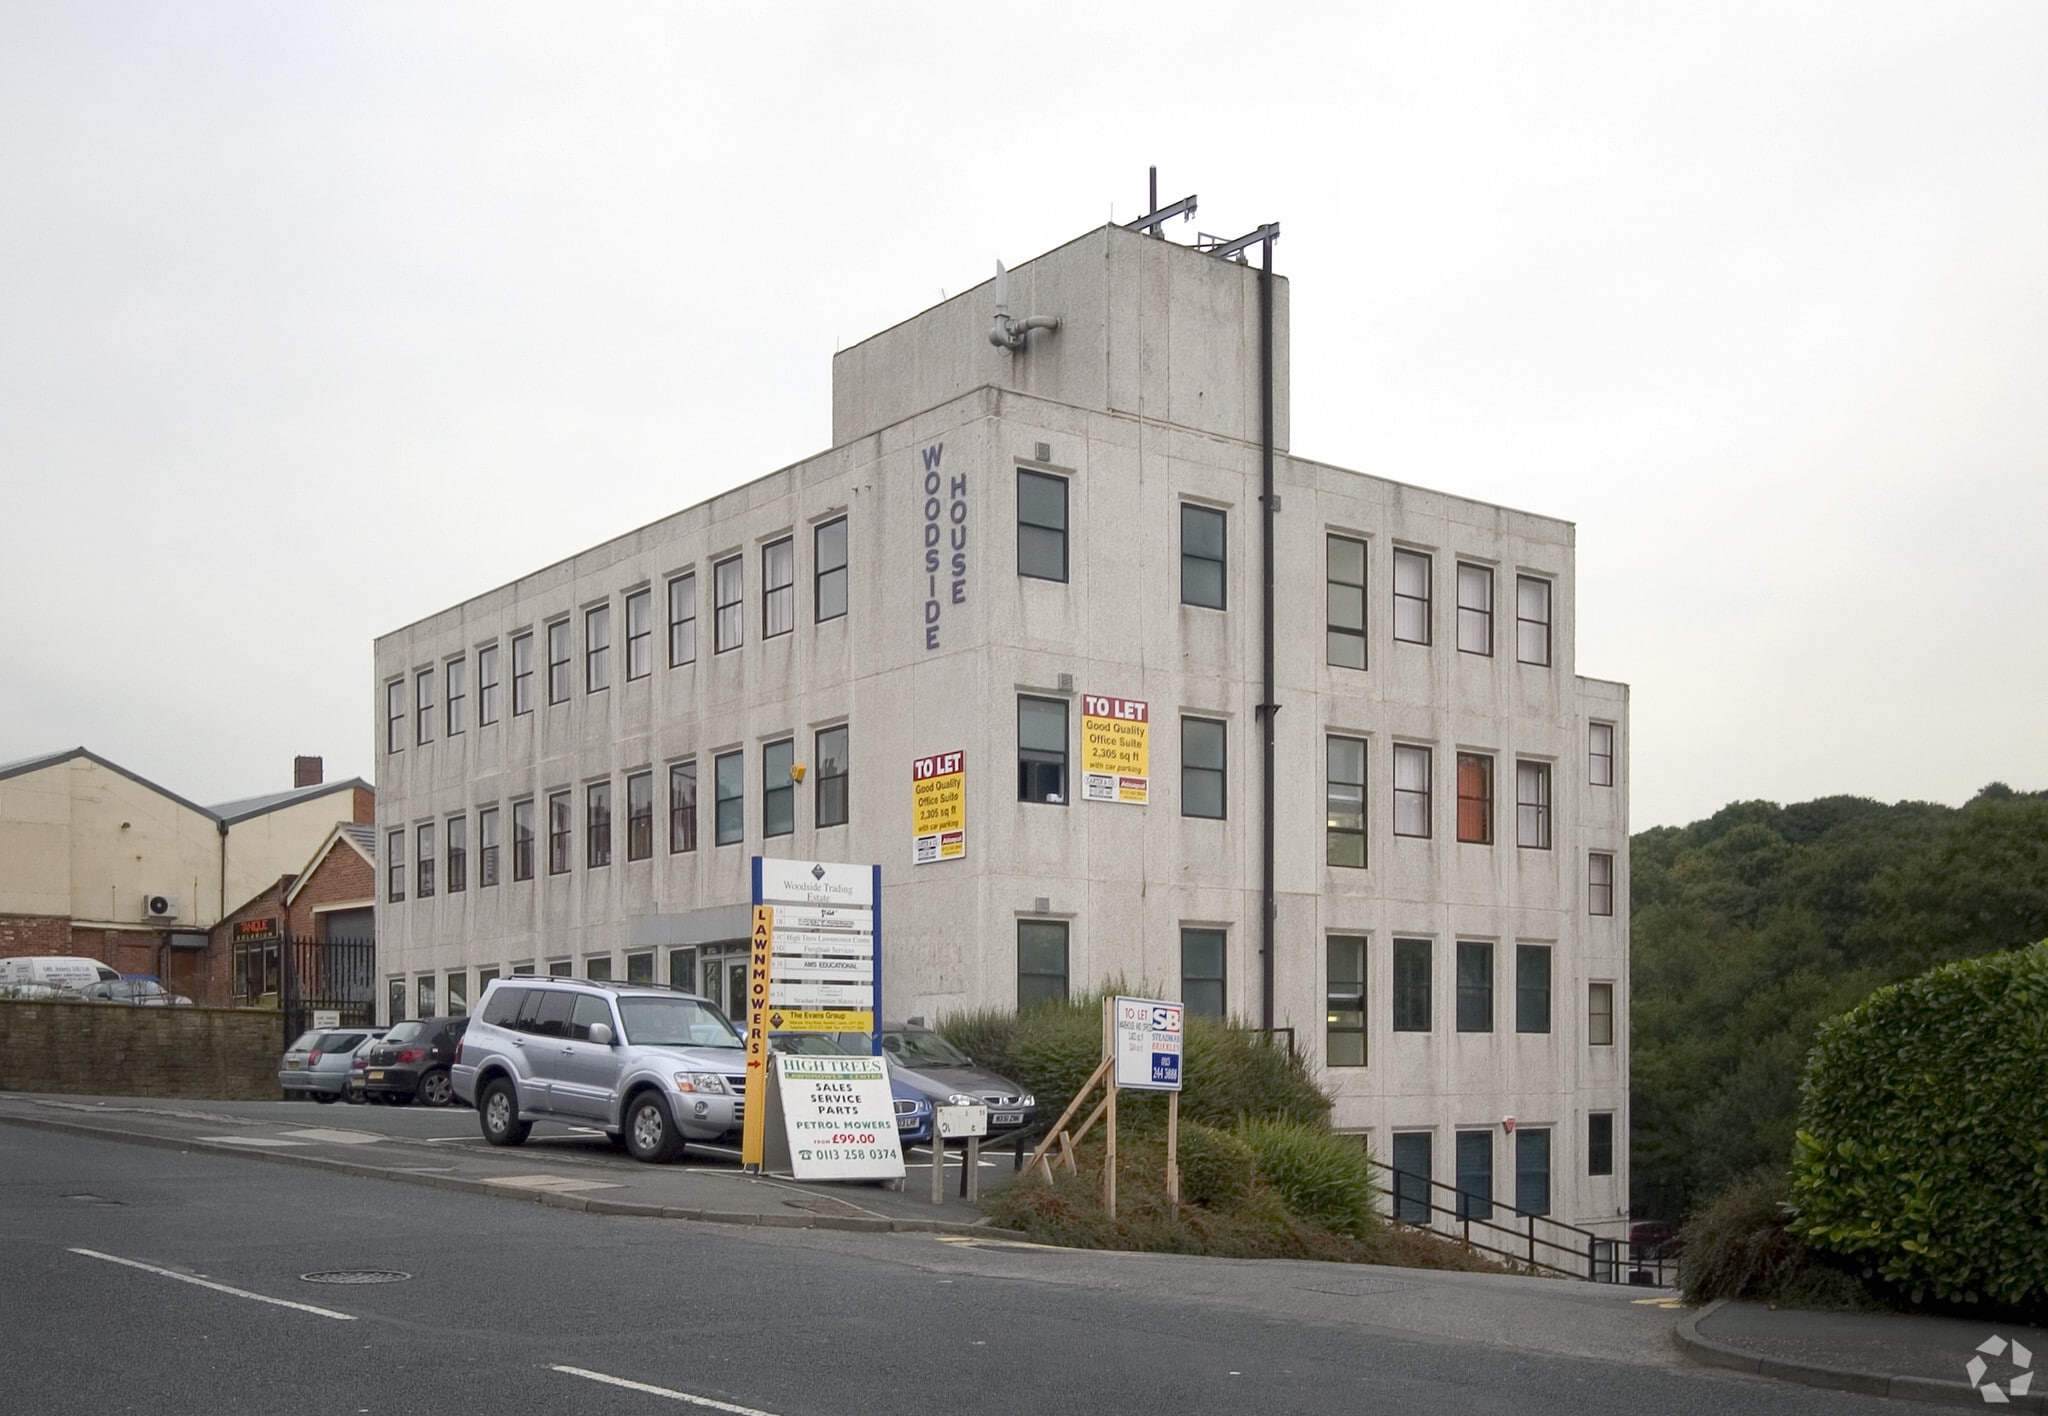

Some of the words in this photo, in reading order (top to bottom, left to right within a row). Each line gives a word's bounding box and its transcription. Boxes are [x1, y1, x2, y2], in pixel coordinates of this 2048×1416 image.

[950, 472, 967, 604] HOUSE
[922, 442, 943, 650] WOODSIDE
[1086, 696, 1109, 716] TO
[1114, 700, 1145, 720] LET
[1086, 720, 1111, 733] Good
[1113, 723, 1145, 738] Quality
[1089, 734, 1117, 746] Office
[1119, 737, 1142, 748] Suite
[1092, 747, 1117, 759] 2,305
[1119, 752, 1130, 762] sq
[1132, 752, 1139, 762] ft
[915, 759, 933, 779] TO
[936, 752, 961, 776] LET
[1089, 761, 1103, 769] with
[1116, 764, 1142, 775] parking
[915, 782, 934, 795] Good
[936, 779, 961, 791] Quality
[918, 797, 938, 808] Office
[940, 792, 958, 803] Suite
[920, 808, 938, 820] 2,305
[941, 809, 949, 818] sq
[950, 806, 956, 815] ft
[918, 824, 928, 832] with
[939, 820, 959, 831] parking
[784, 880, 820, 891] Woodside
[824, 883, 853, 895] Trading
[807, 893, 830, 902] Estate
[819, 961, 858, 969] EDUCATIONAL
[751, 909, 767, 1054] LAWNMOWERS
[825, 1012, 846, 1020] Group
[1125, 1008, 1135, 1019] TO
[1137, 1009, 1148, 1020] LET
[1152, 1008, 1180, 1032] SB
[783, 1059, 825, 1071] HIGH
[827, 1060, 881, 1072] TREES
[815, 1083, 853, 1092] SALES
[810, 1094, 862, 1103] SERVICE
[818, 1106, 858, 1115] PARTS
[796, 1121, 840, 1129] PETROL
[844, 1121, 891, 1129] MOWERS
[832, 1134, 875, 1144] £99.00
[816, 1149, 839, 1160] 0113
[844, 1149, 865, 1160] 258
[869, 1149, 896, 1160] 0374
